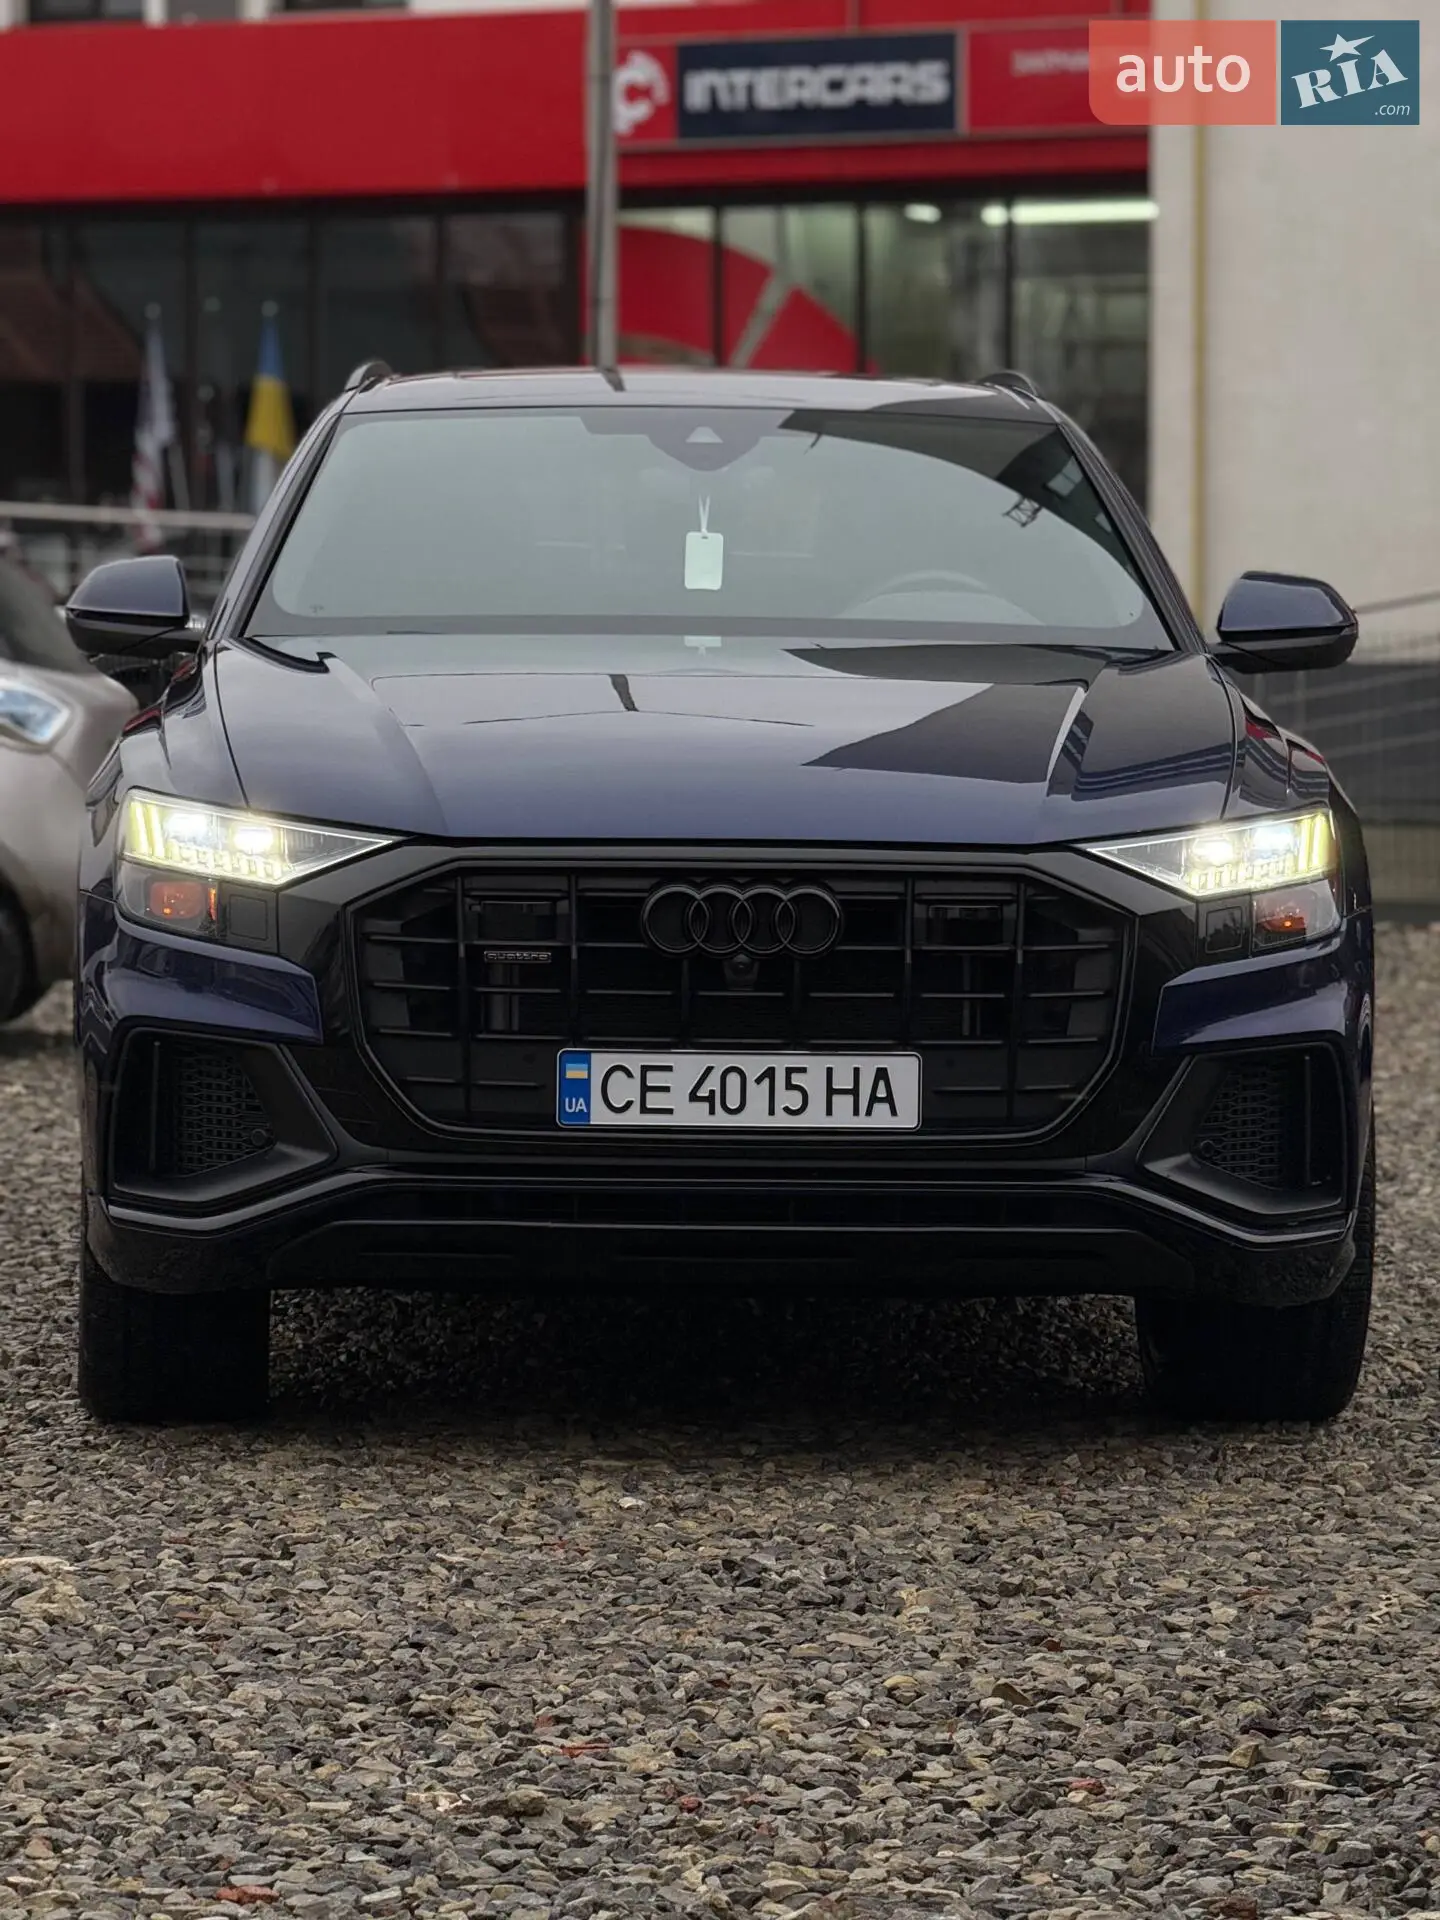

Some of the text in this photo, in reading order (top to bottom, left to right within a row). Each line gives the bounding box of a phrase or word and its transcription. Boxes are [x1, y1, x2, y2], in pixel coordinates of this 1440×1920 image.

[565, 1097, 588, 1113] UA
[601, 1064, 899, 1117] CE 4015 HA
